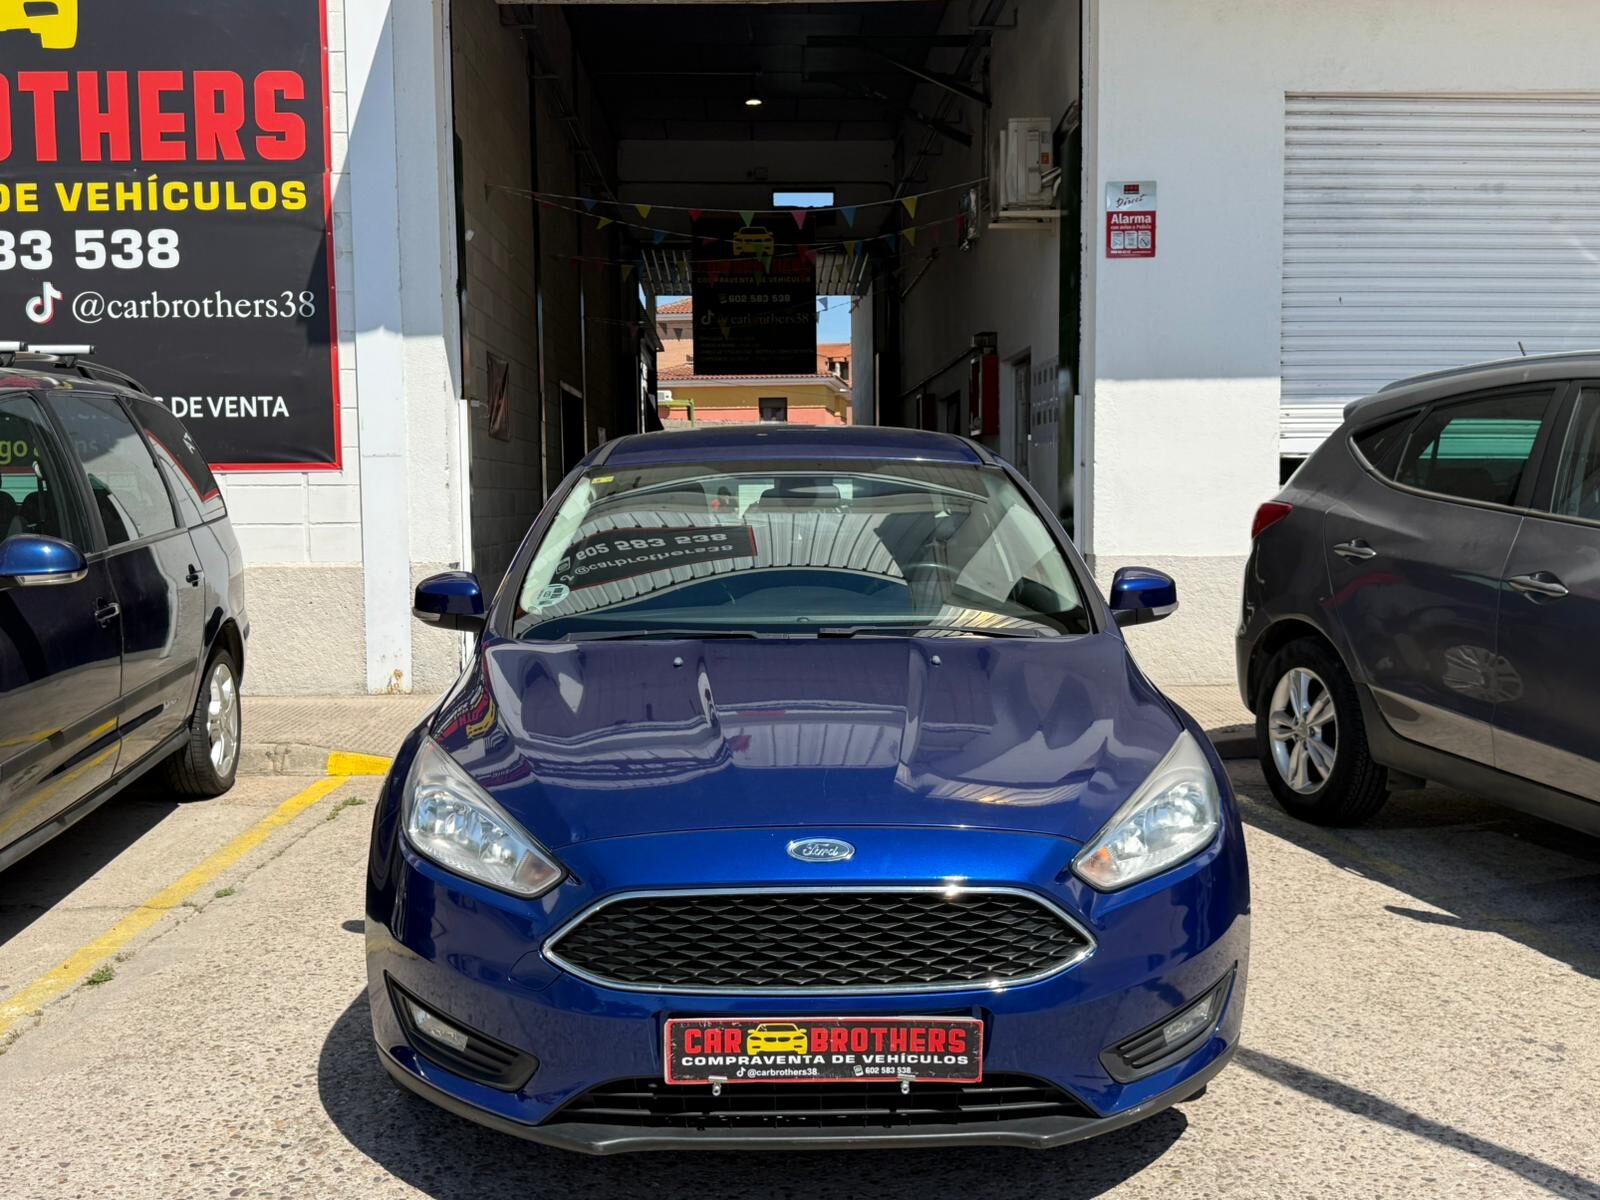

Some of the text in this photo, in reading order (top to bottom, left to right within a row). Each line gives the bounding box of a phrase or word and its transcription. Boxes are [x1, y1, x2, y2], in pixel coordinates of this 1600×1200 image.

[55, 174, 307, 212] VEHÍCULOS
[1111, 213, 1152, 224] Alarma
[75, 229, 180, 270] 538
[72, 290, 316, 324] @carbrothers38
[171, 396, 290, 418] DE VENTA
[684, 1026, 968, 1055] CAR BROTHERS
[681, 1053, 969, 1066] COMPRAVENTA DE VEHÍCULOS
[747, 1066, 911, 1079] @carbrothers38 602 583 538
